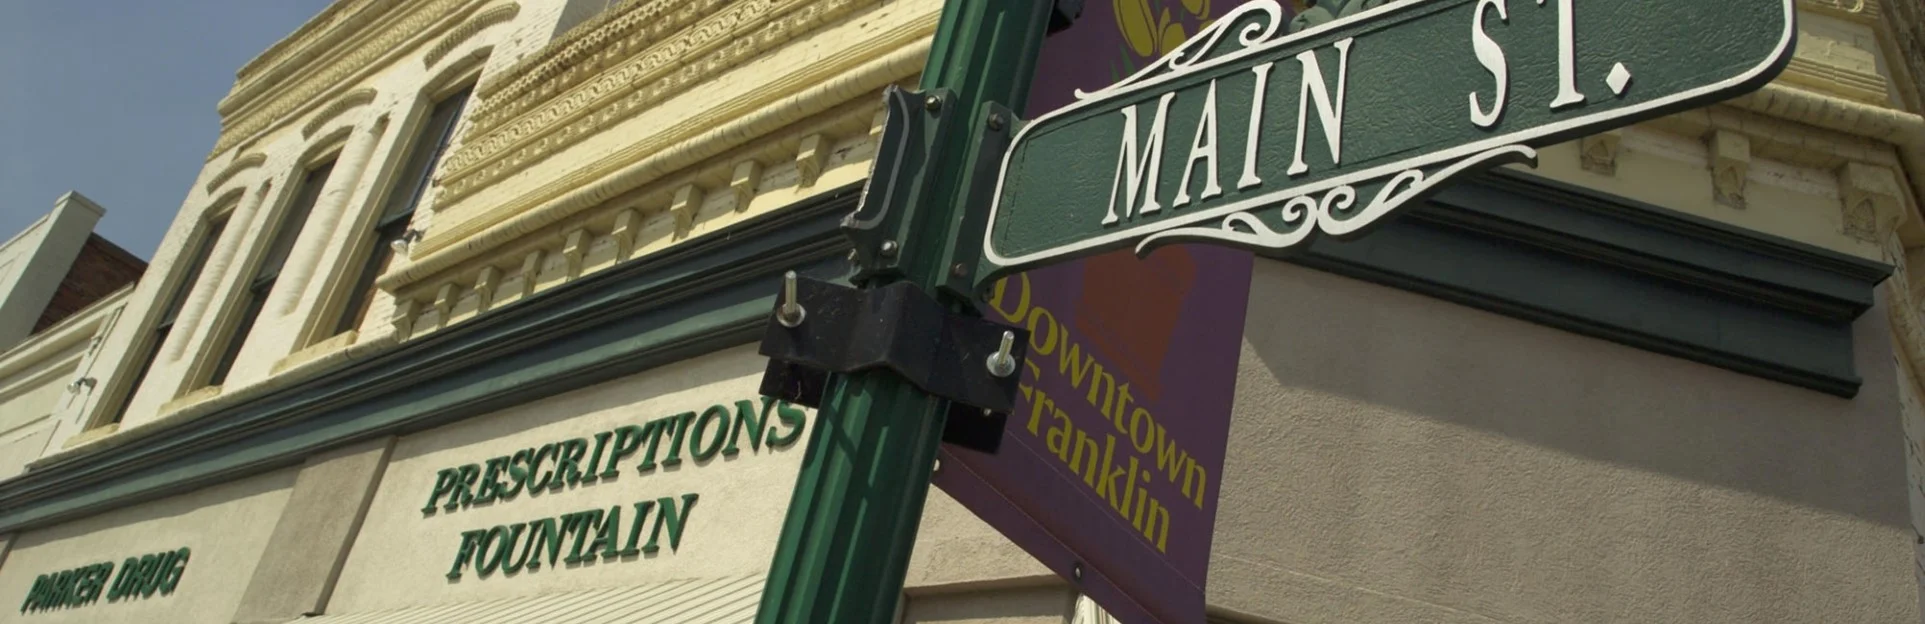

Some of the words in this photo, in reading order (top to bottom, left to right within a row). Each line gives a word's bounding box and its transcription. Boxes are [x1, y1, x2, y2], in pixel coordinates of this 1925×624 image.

[1102, 37, 1354, 225] MAIN
[1469, 0, 1632, 127] ST.
[989, 270, 1207, 510] Downtown
[421, 396, 807, 516] PRESCRIPTIONS
[20, 561, 114, 615] PARKER
[107, 546, 191, 602] DRUG
[446, 493, 700, 582] FOUNTAIN
